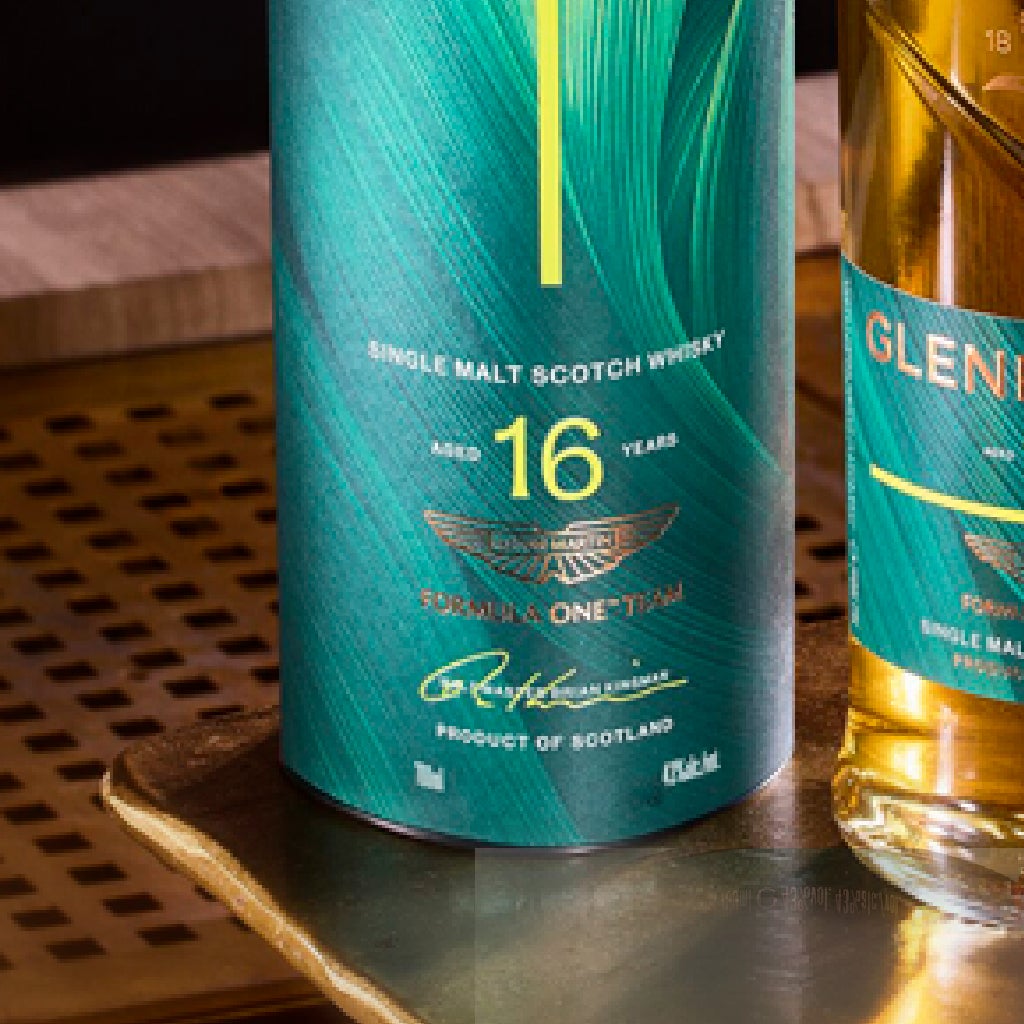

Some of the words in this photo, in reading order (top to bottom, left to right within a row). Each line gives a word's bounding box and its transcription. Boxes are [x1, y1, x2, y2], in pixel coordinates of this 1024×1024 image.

[985, 28, 1012, 55] 18
[368, 340, 447, 376] SINGLE
[455, 356, 524, 384] MALT
[530, 355, 642, 387] SCOTCH
[647, 329, 726, 369] WHISKY
[494, 415, 604, 501] 16
[621, 433, 679, 457] YEARS
[420, 587, 542, 624] FORMULA
[622, 580, 684, 617] TEAM
[921, 619, 982, 651] SINGLE
[435, 721, 529, 751] PRODUCT
[535, 734, 563, 752] OF
[571, 715, 674, 752] SCOTLAND
